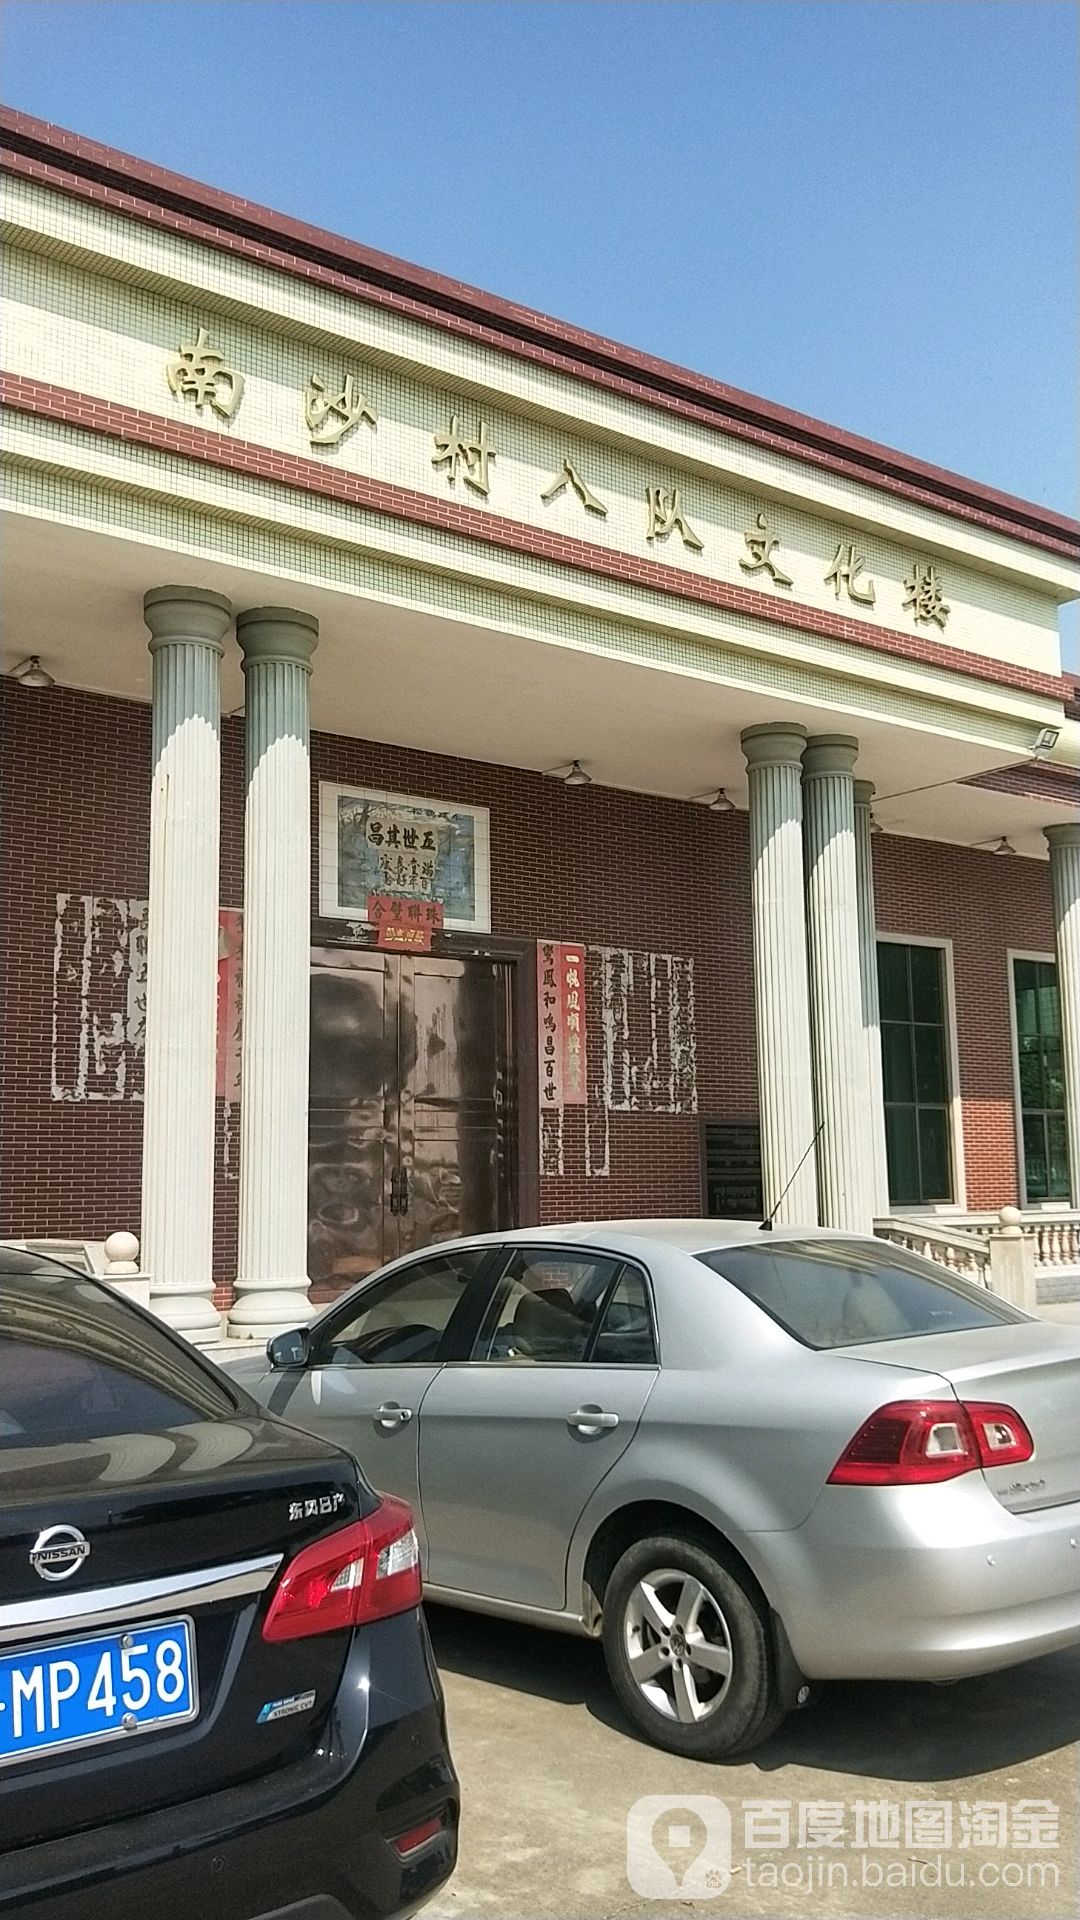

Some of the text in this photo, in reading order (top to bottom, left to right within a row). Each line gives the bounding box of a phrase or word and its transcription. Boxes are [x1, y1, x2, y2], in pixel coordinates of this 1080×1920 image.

[289, 1491, 346, 1521] 东风日产
[36, 1545, 86, 1561] NISSAN
